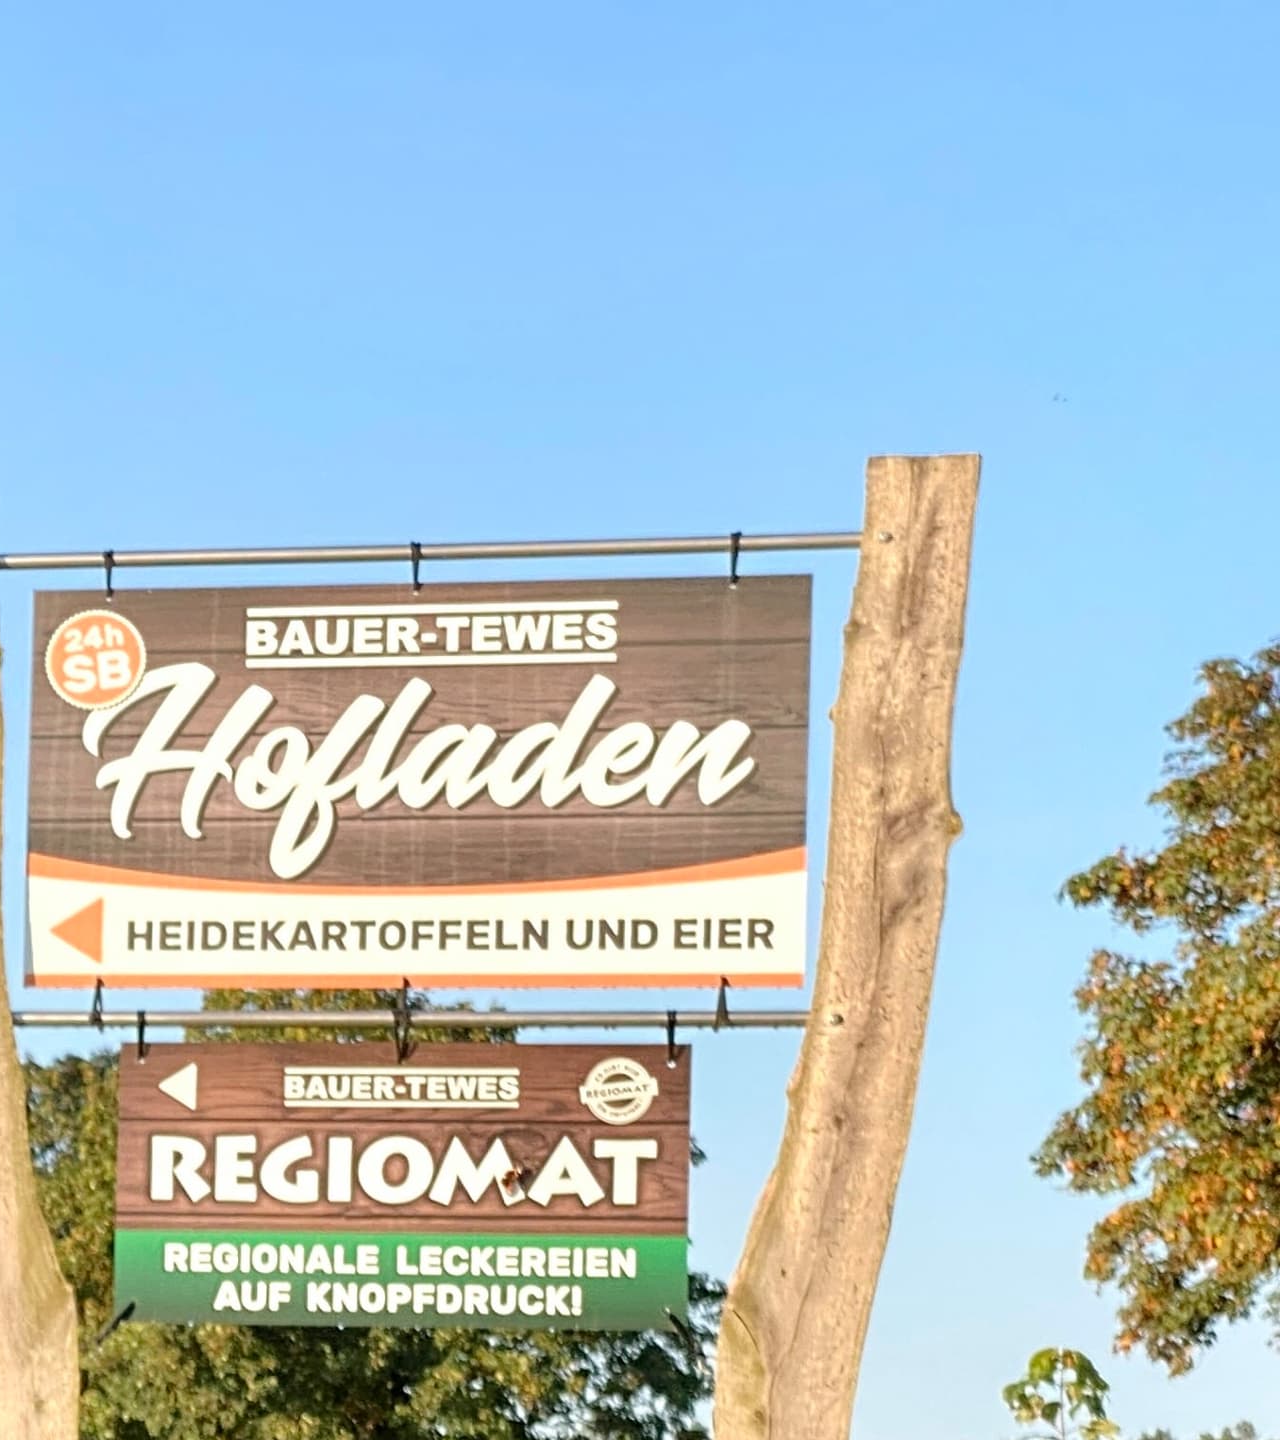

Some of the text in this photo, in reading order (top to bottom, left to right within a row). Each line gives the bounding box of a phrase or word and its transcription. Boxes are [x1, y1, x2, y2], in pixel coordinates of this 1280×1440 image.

[63, 623, 125, 653] 24h
[246, 614, 618, 656] BAUER-TEWES
[62, 649, 132, 693] SB
[81, 661, 756, 879] Hofladen
[126, 917, 776, 952] HEIDEKARTOFFELN UND EIER
[283, 1075, 521, 1101] BAUER-TEWES
[151, 1135, 657, 1207] REGIOMAT
[163, 1242, 638, 1279] REGIONALE LECKEREIEN
[212, 1281, 583, 1317] AUF KNOPFDRUCK!
